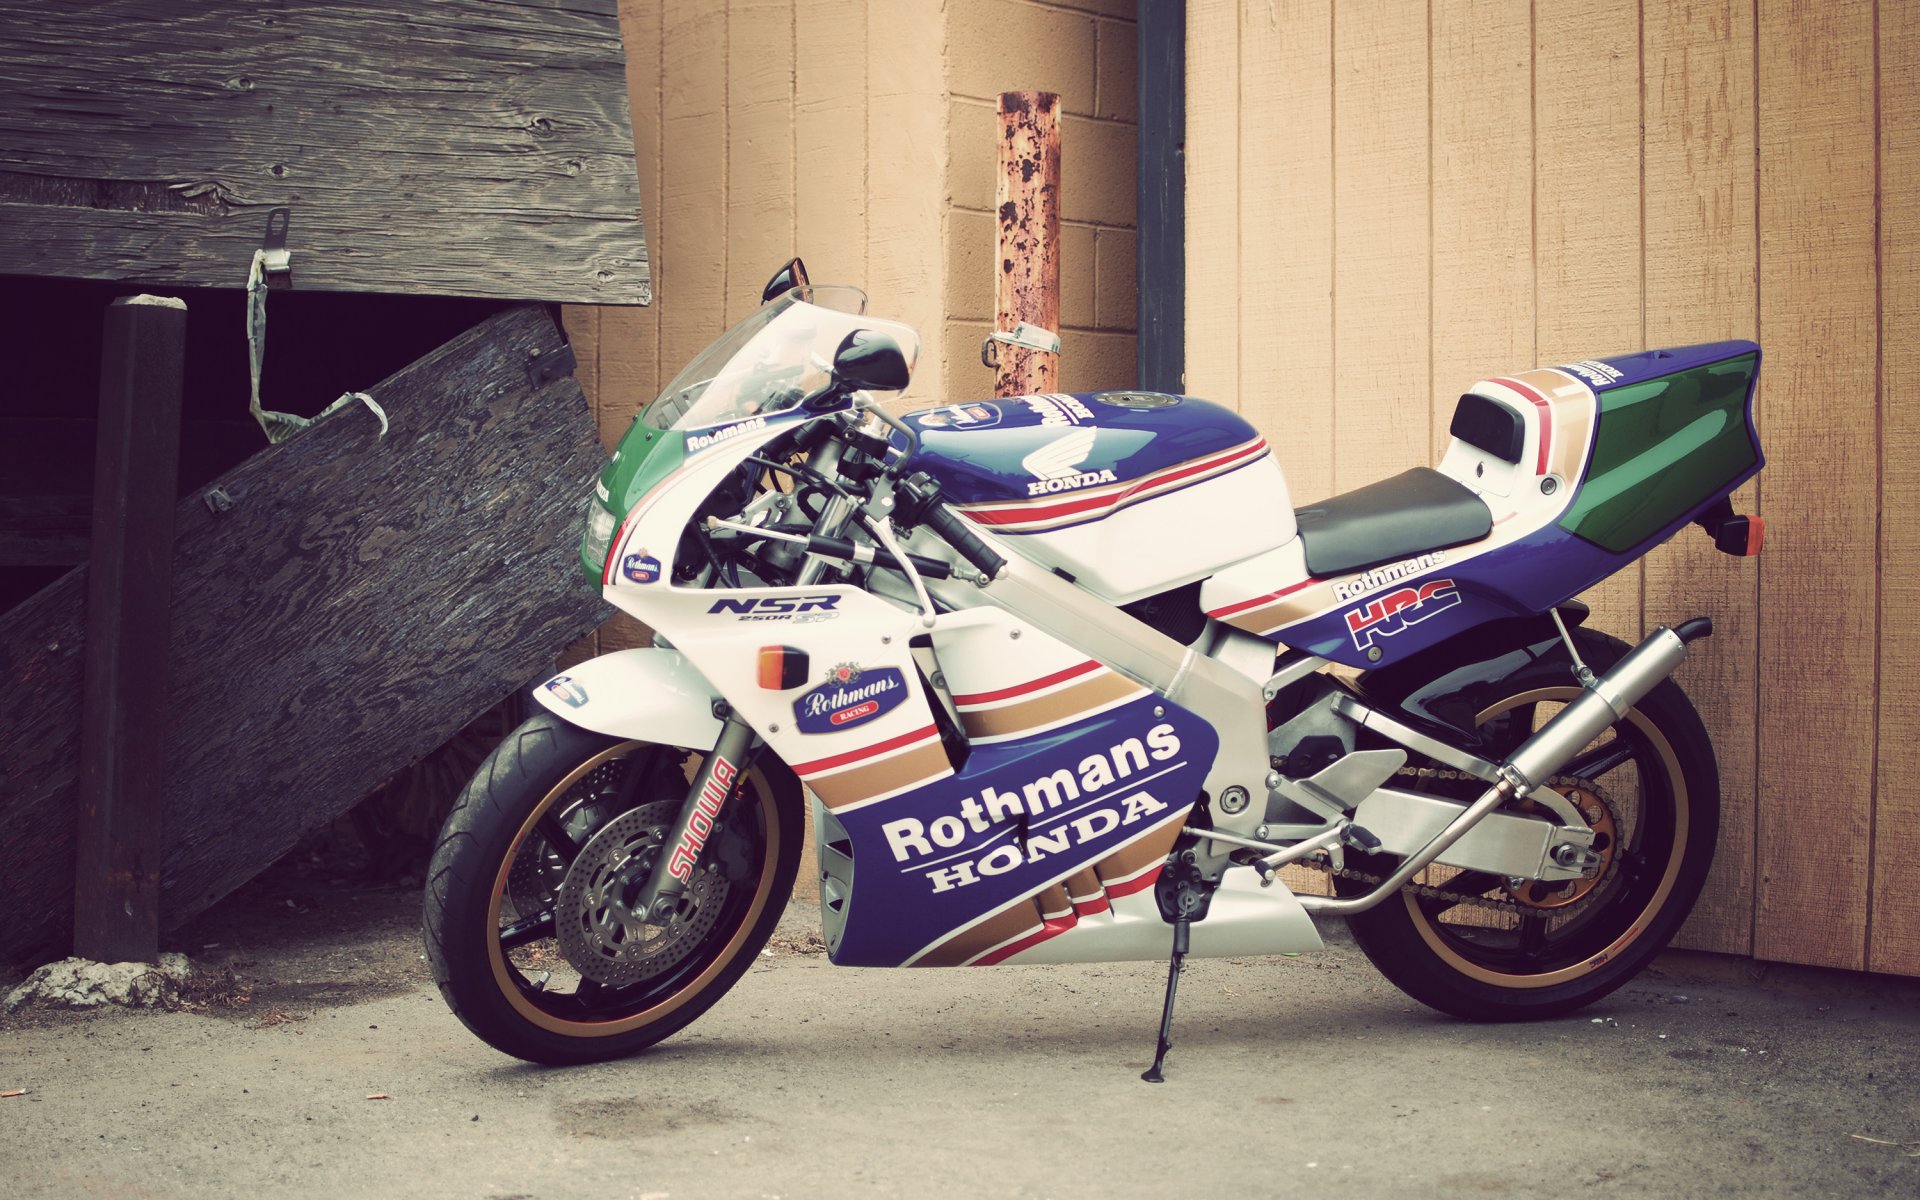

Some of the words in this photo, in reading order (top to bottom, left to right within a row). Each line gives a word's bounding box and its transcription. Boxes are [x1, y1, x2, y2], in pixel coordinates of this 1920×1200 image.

[1027, 468, 1118, 496] HONDA
[1331, 550, 1447, 603] Rothmans
[707, 594, 842, 614] NSR
[738, 614, 792, 622] 250R
[1344, 578, 1462, 652] HRC
[804, 674, 900, 718] Rothmans
[839, 705, 870, 721] RACING
[881, 723, 1181, 863] Rothmans
[668, 755, 738, 886] SHOWA
[925, 790, 1168, 894] HONDA
